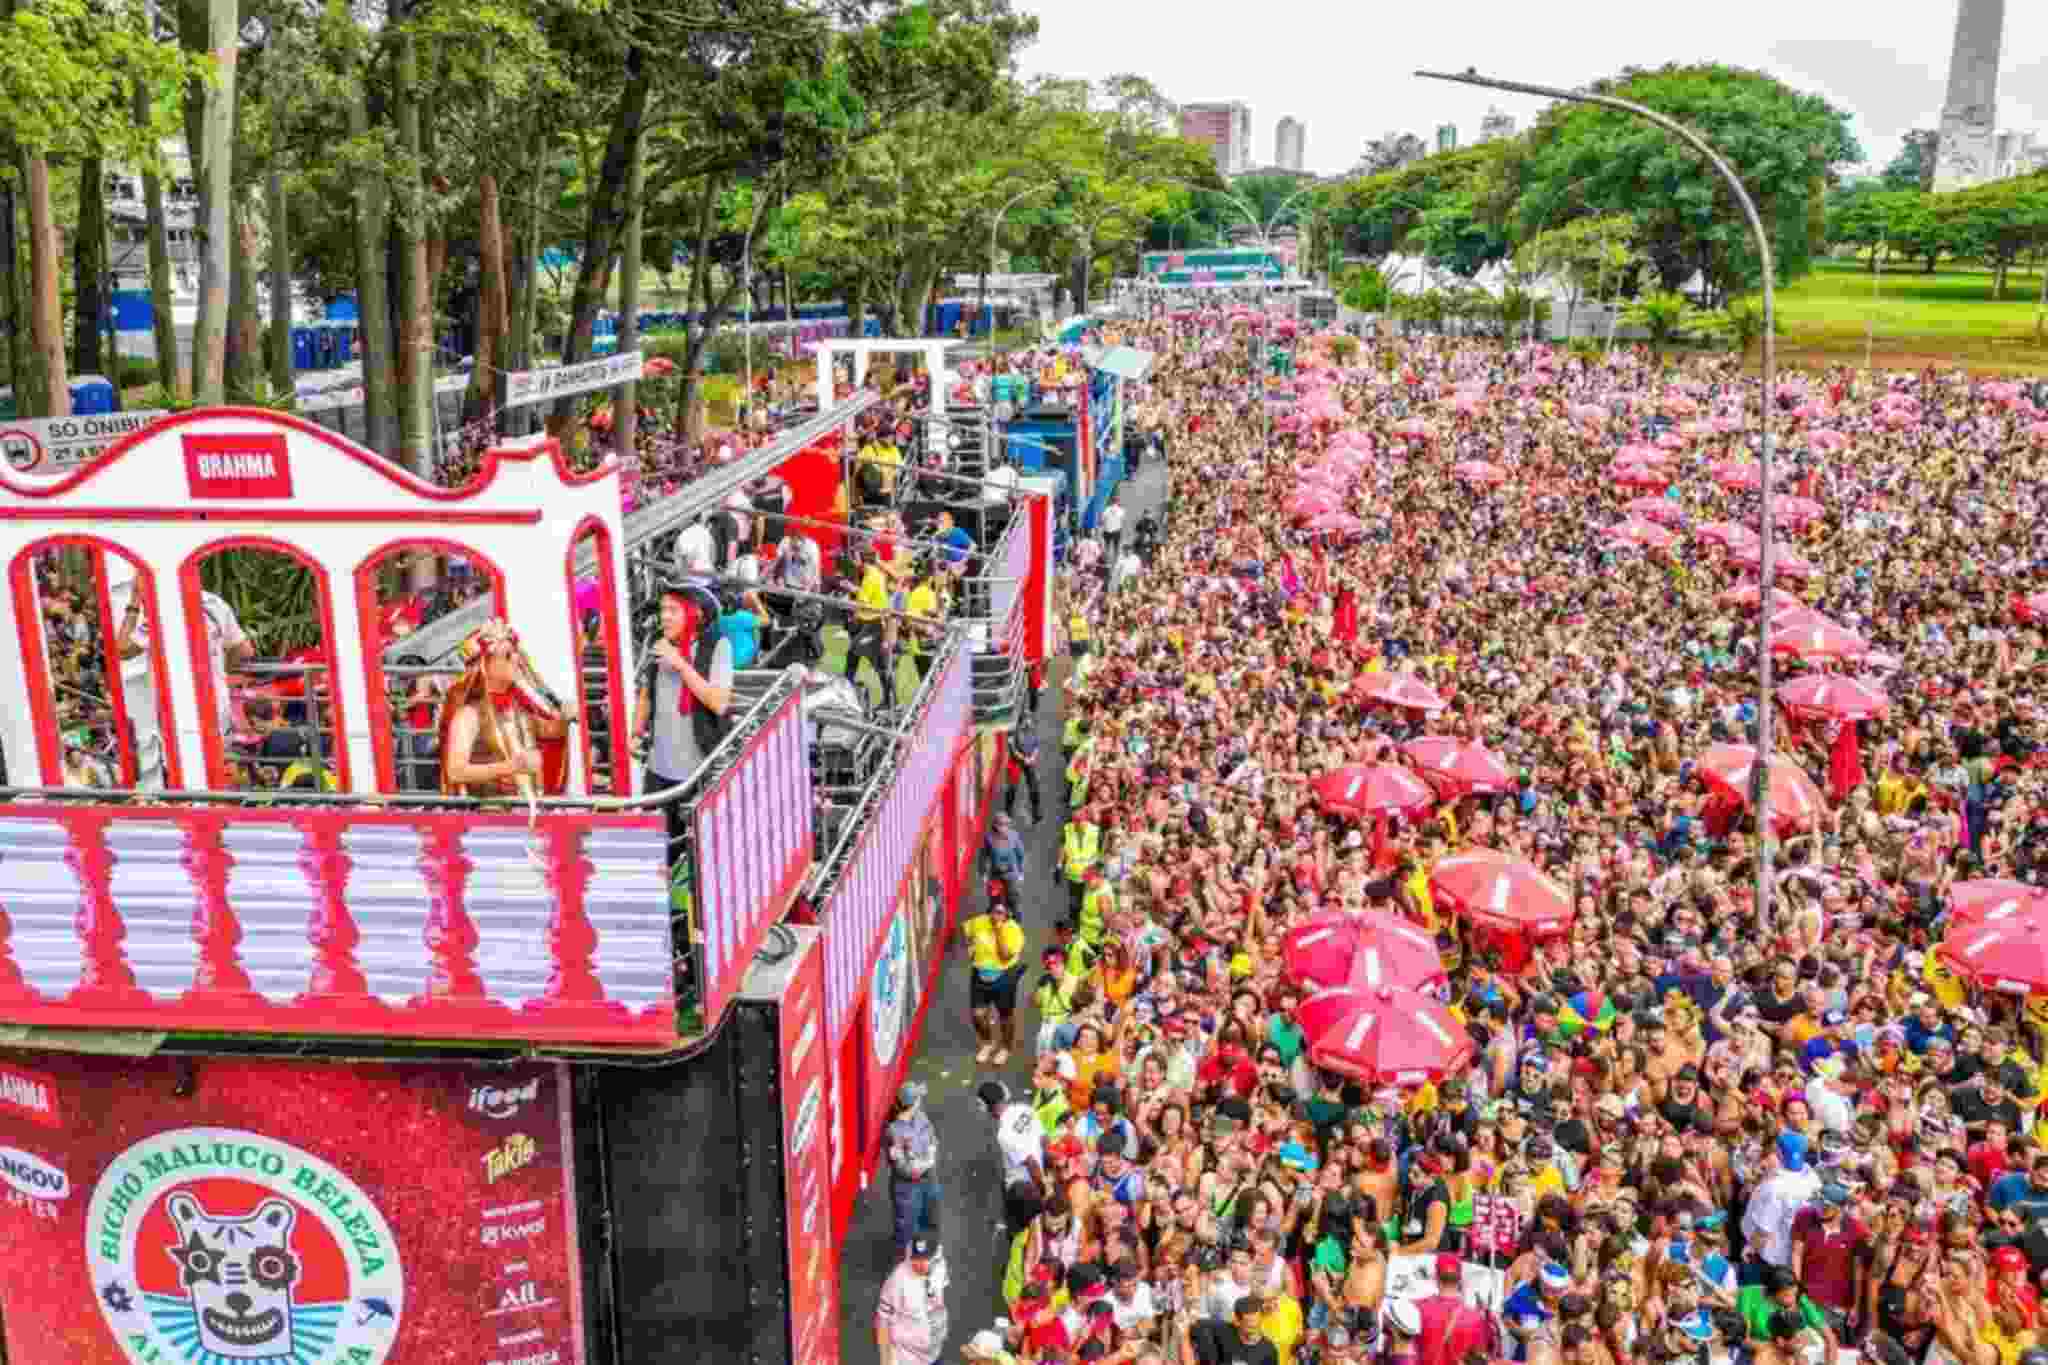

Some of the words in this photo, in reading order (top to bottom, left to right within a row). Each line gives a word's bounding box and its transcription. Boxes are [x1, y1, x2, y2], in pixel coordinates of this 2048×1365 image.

[197, 451, 276, 480] BRAHMA
[101, 1171, 142, 1262] BICHO
[140, 1143, 284, 1179] MALUCO
[291, 1167, 385, 1277] BELEZA
